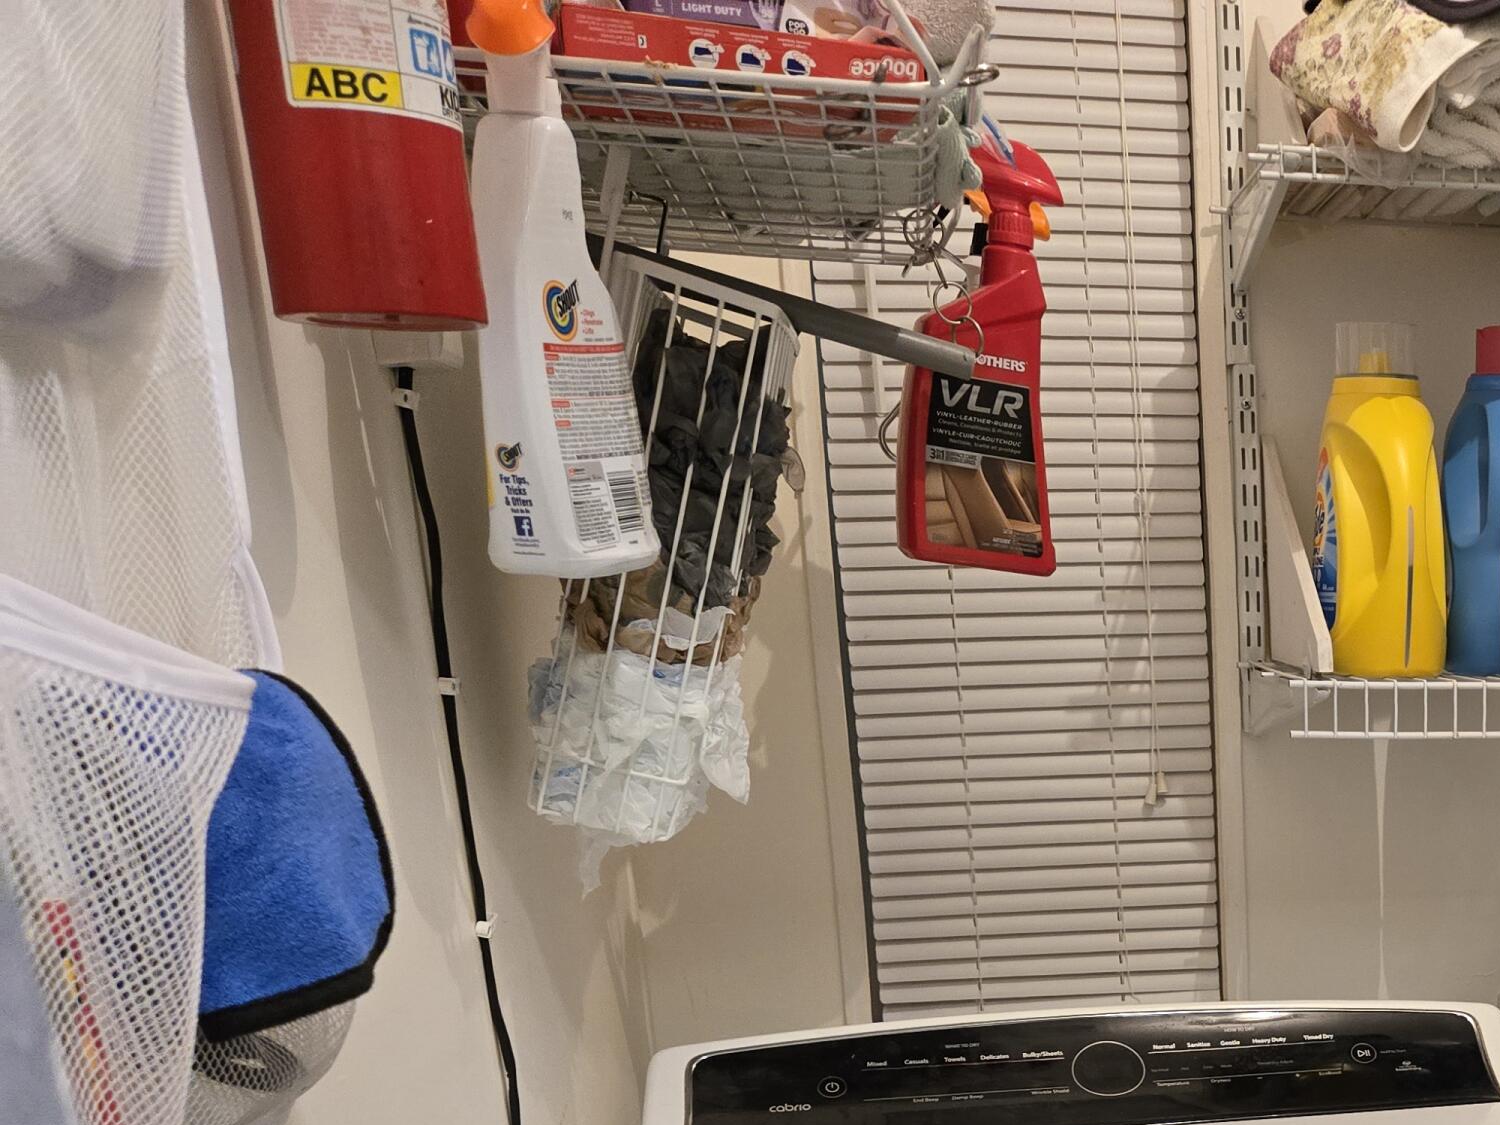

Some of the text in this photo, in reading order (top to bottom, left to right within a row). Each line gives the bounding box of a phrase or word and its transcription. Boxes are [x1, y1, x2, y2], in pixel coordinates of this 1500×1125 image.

[682, 3, 742, 17] LIGHT DUTY
[789, 20, 806, 28] POP
[305, 67, 390, 104] ABC
[976, 353, 1026, 373] OTHERS
[940, 379, 1025, 419] VLR
[499, 473, 511, 484] For
[505, 485, 528, 496] Tricks
[511, 496, 533, 507] Offers
[1022, 1050, 1064, 1059] Bulky/Sheets
[768, 1103, 812, 1113] cabrio
